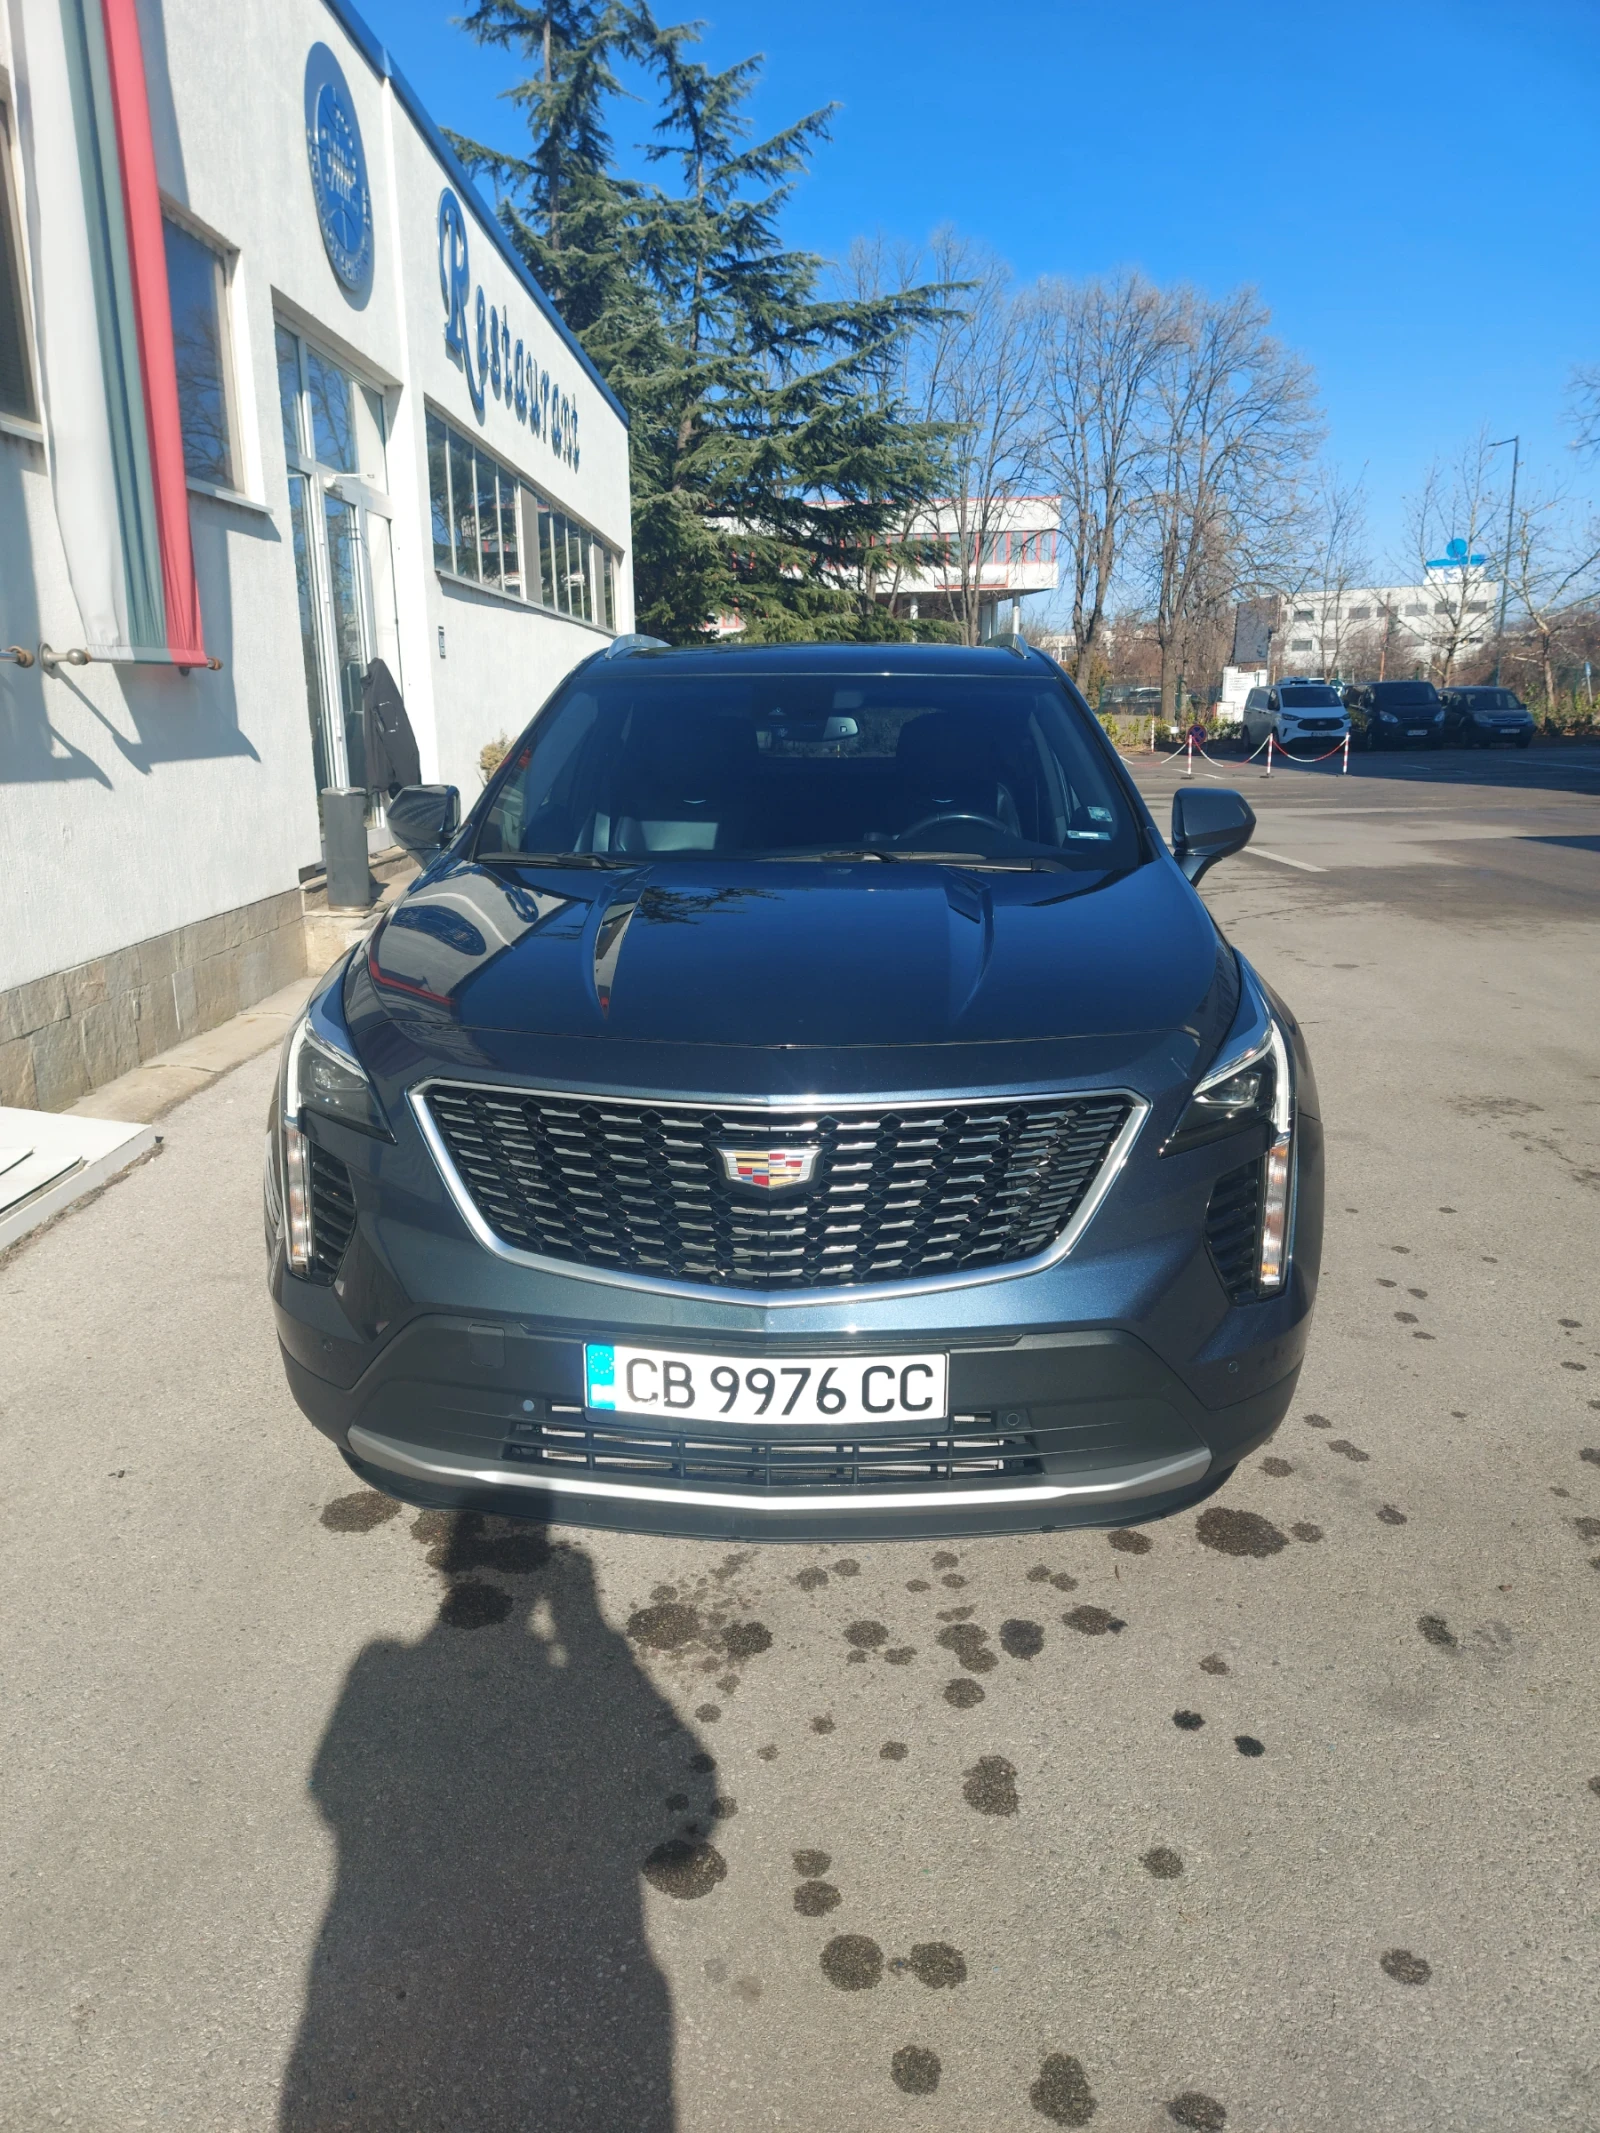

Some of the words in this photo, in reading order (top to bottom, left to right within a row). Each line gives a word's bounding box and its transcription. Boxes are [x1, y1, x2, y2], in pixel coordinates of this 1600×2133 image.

[437, 187, 580, 472] Restaurant
[626, 1357, 696, 1409] CB
[710, 1366, 846, 1416] 9976
[861, 1363, 934, 1413] CC
